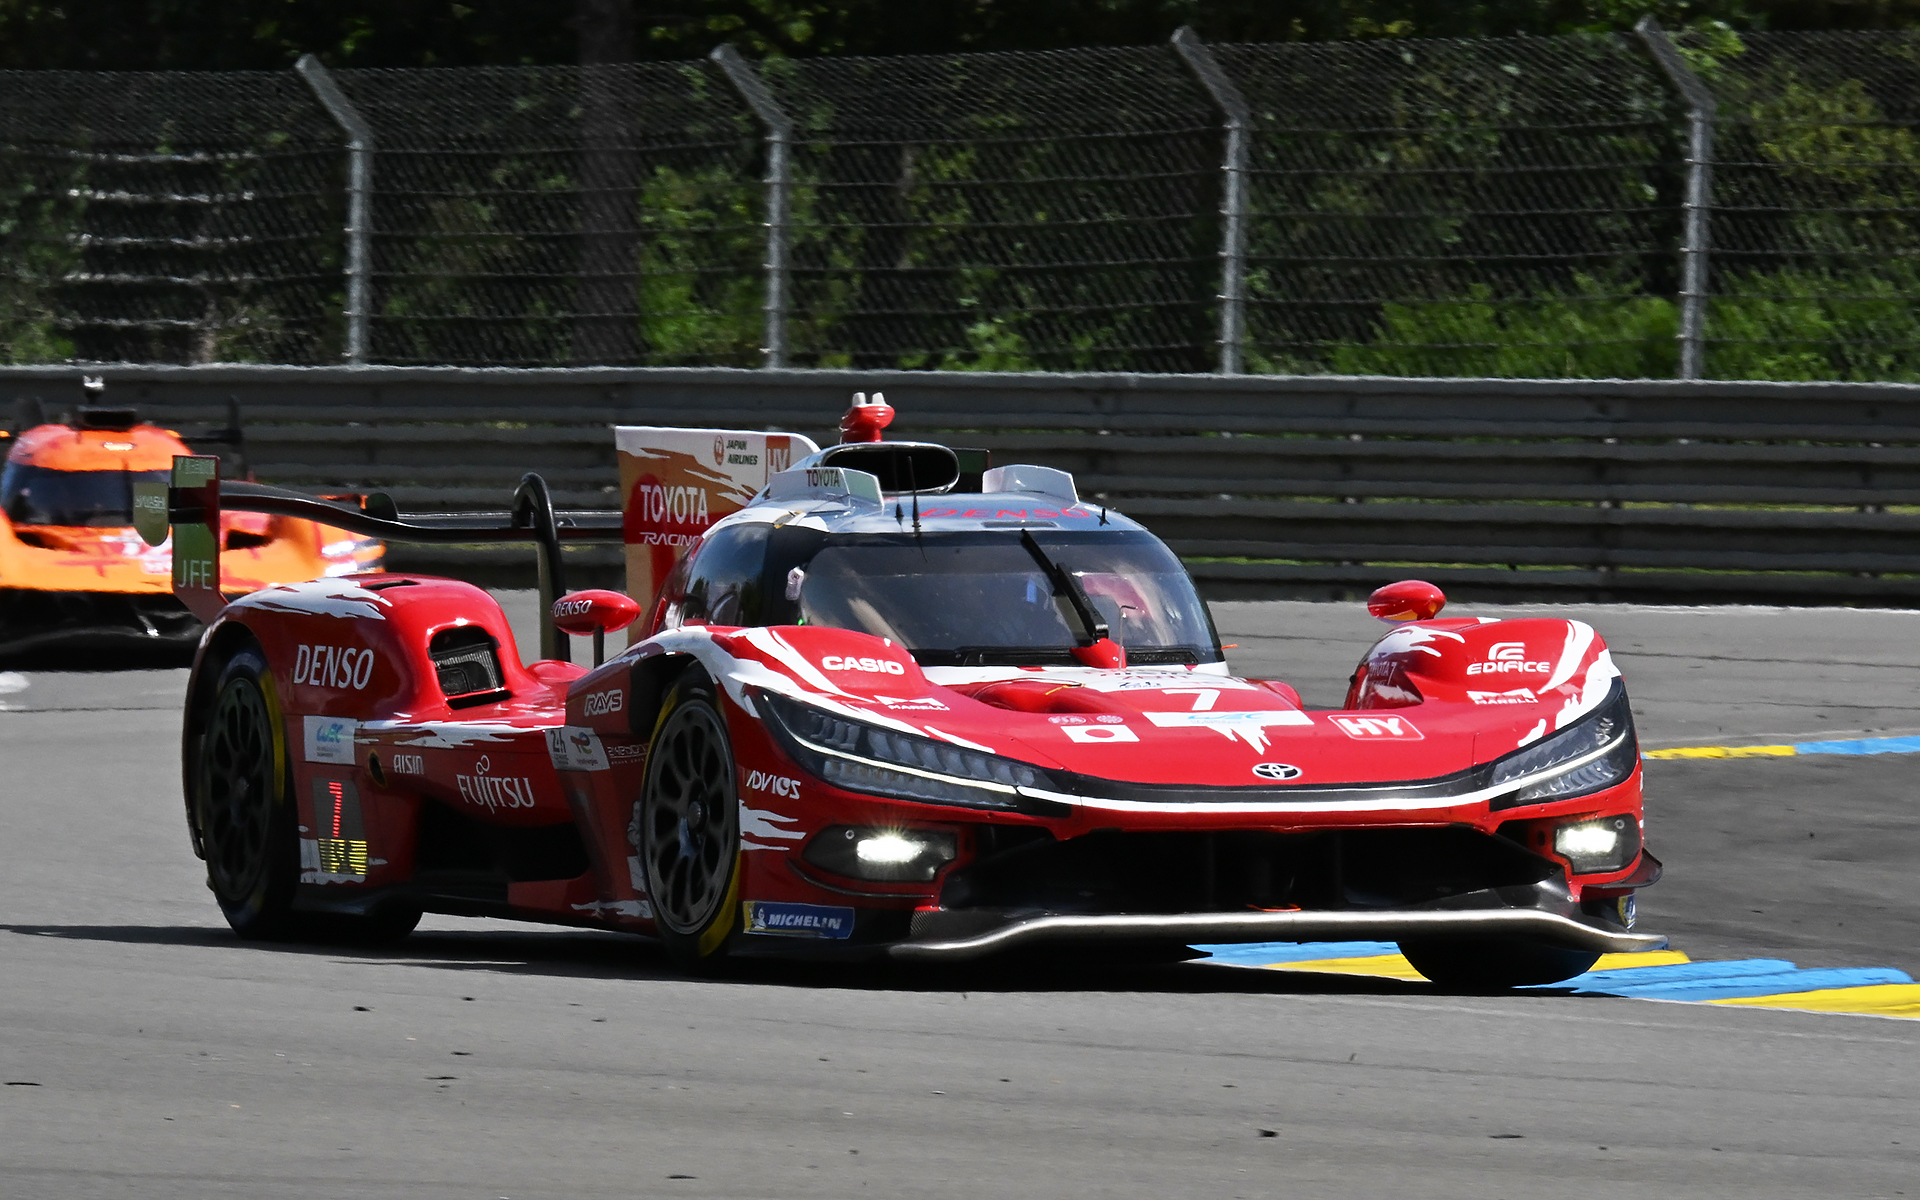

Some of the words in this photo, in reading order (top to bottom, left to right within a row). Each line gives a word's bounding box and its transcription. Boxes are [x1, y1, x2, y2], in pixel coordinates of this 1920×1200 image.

[726, 440, 747, 450] JAPAN
[727, 454, 758, 465] AIRLINES
[806, 469, 840, 487] TOYOTA
[640, 485, 709, 525] TOYOTA
[919, 508, 1090, 518] DENSO
[178, 559, 213, 590] JFE
[555, 600, 593, 617] DENSO
[293, 644, 374, 690] DENSO
[822, 656, 905, 675] CASIO
[1466, 661, 1550, 675] EDIFICE
[584, 689, 623, 717] RAYS
[1162, 688, 1221, 710] 7
[1337, 718, 1404, 735] HY
[393, 754, 424, 774] AISIN
[456, 774, 535, 814] FUJITSU
[746, 770, 801, 799] ADVICS
[767, 913, 842, 930] MICHELIN
